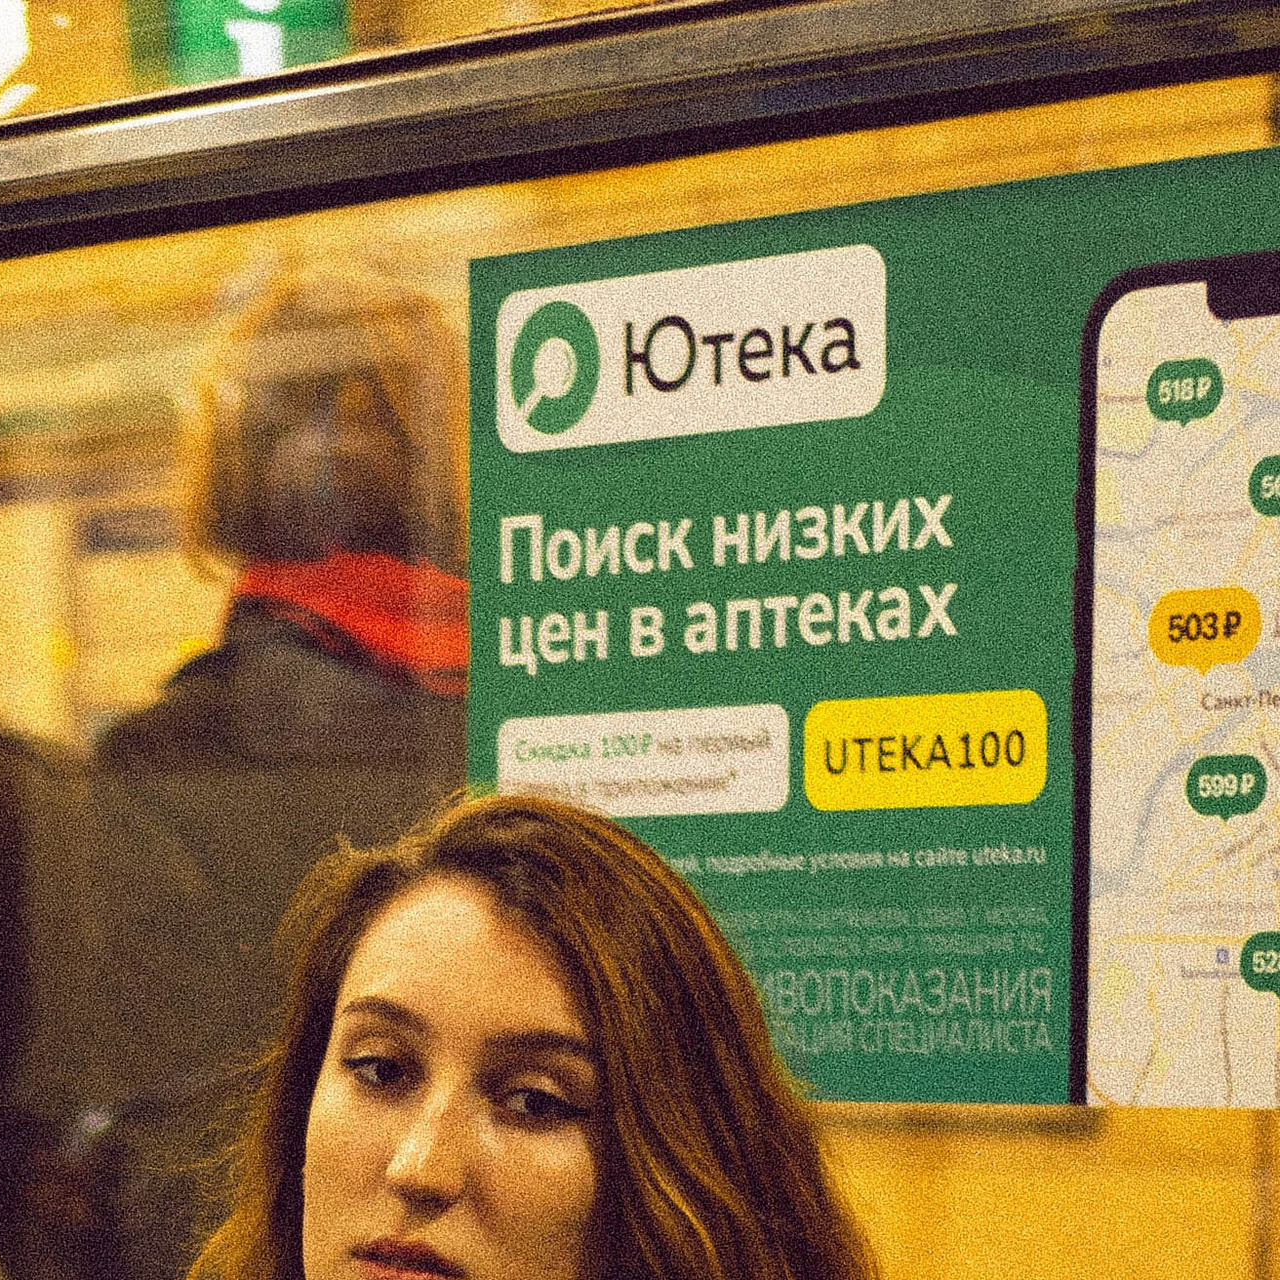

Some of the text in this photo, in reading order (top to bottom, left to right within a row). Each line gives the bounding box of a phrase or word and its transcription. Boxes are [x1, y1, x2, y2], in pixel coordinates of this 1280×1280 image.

[624, 314, 862, 397] Ютека
[499, 493, 954, 583] Поиск низких
[498, 582, 959, 676] цен в аптеках
[514, 740, 591, 762] Скидка
[824, 729, 1025, 777] UTEKA100
[707, 848, 804, 876] подробные
[809, 850, 884, 875] условия
[887, 850, 911, 868] на
[915, 846, 967, 867] сайте
[971, 841, 1047, 866] uteka.ru
[860, 1019, 1053, 1056] СПЕЦИАЛИСТА
